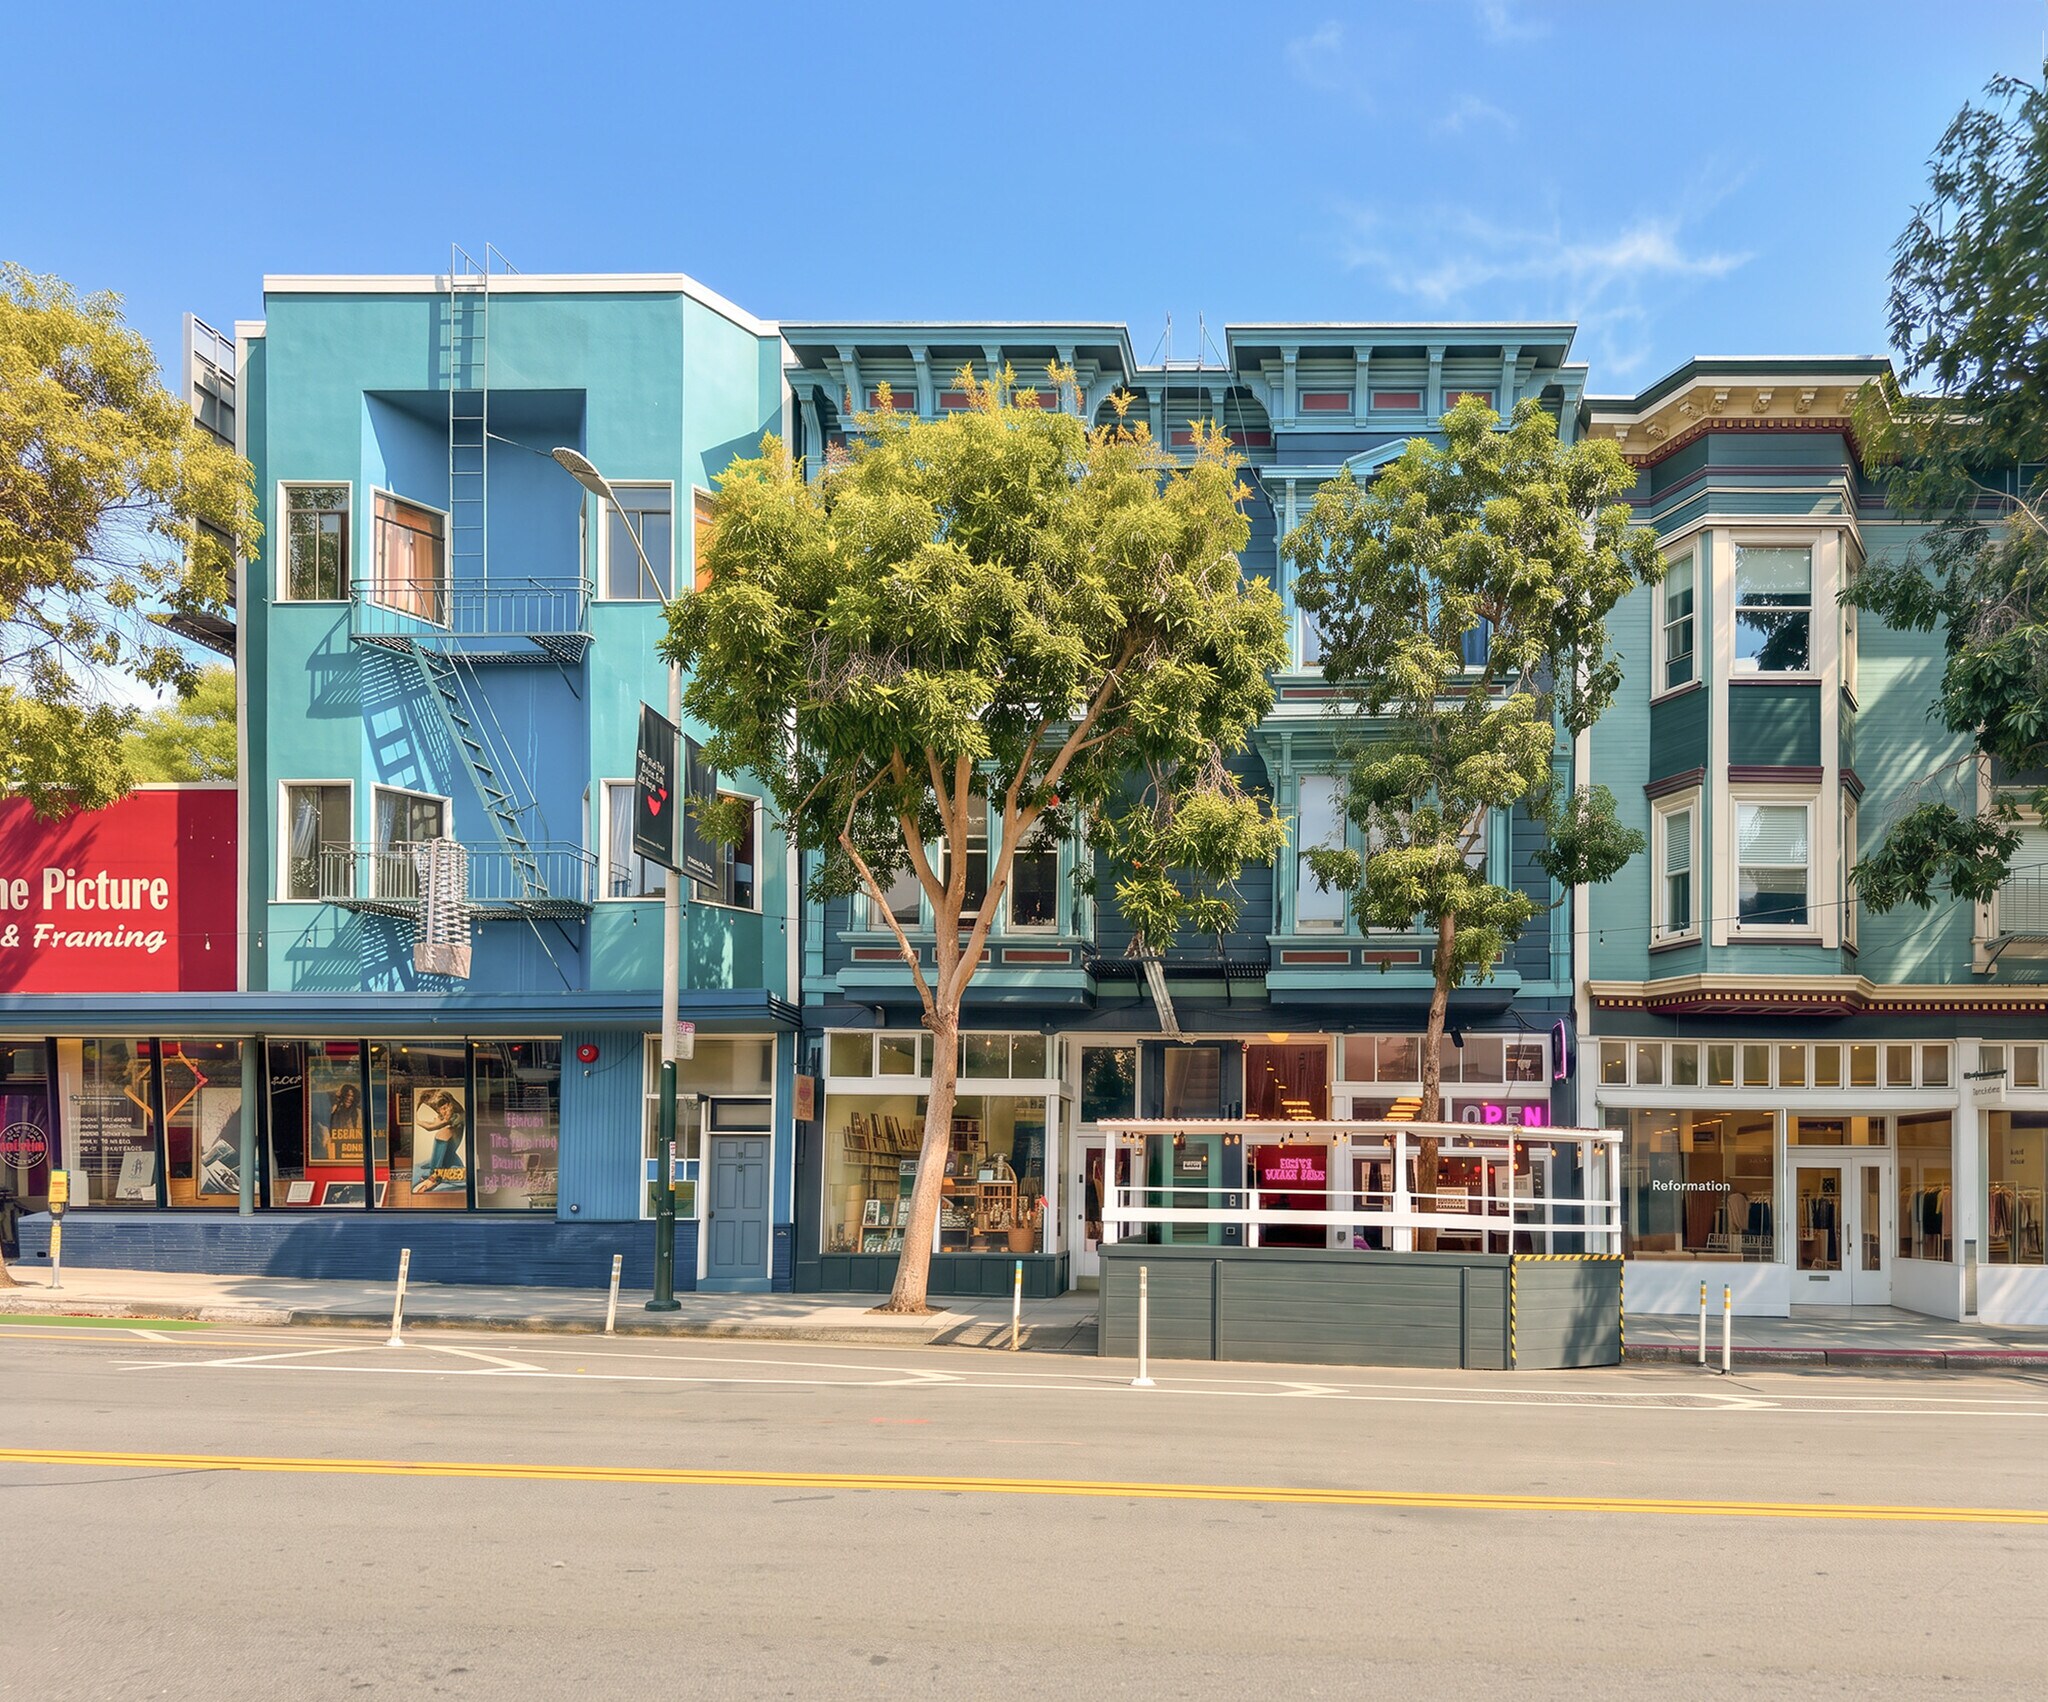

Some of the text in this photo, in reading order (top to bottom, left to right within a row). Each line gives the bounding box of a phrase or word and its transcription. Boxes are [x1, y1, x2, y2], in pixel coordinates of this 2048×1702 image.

[43, 868, 168, 910] Picture
[0, 923, 167, 953] & Framing
[1462, 1105, 1542, 1127] OPEN
[1652, 1180, 1731, 1191] Reformation
